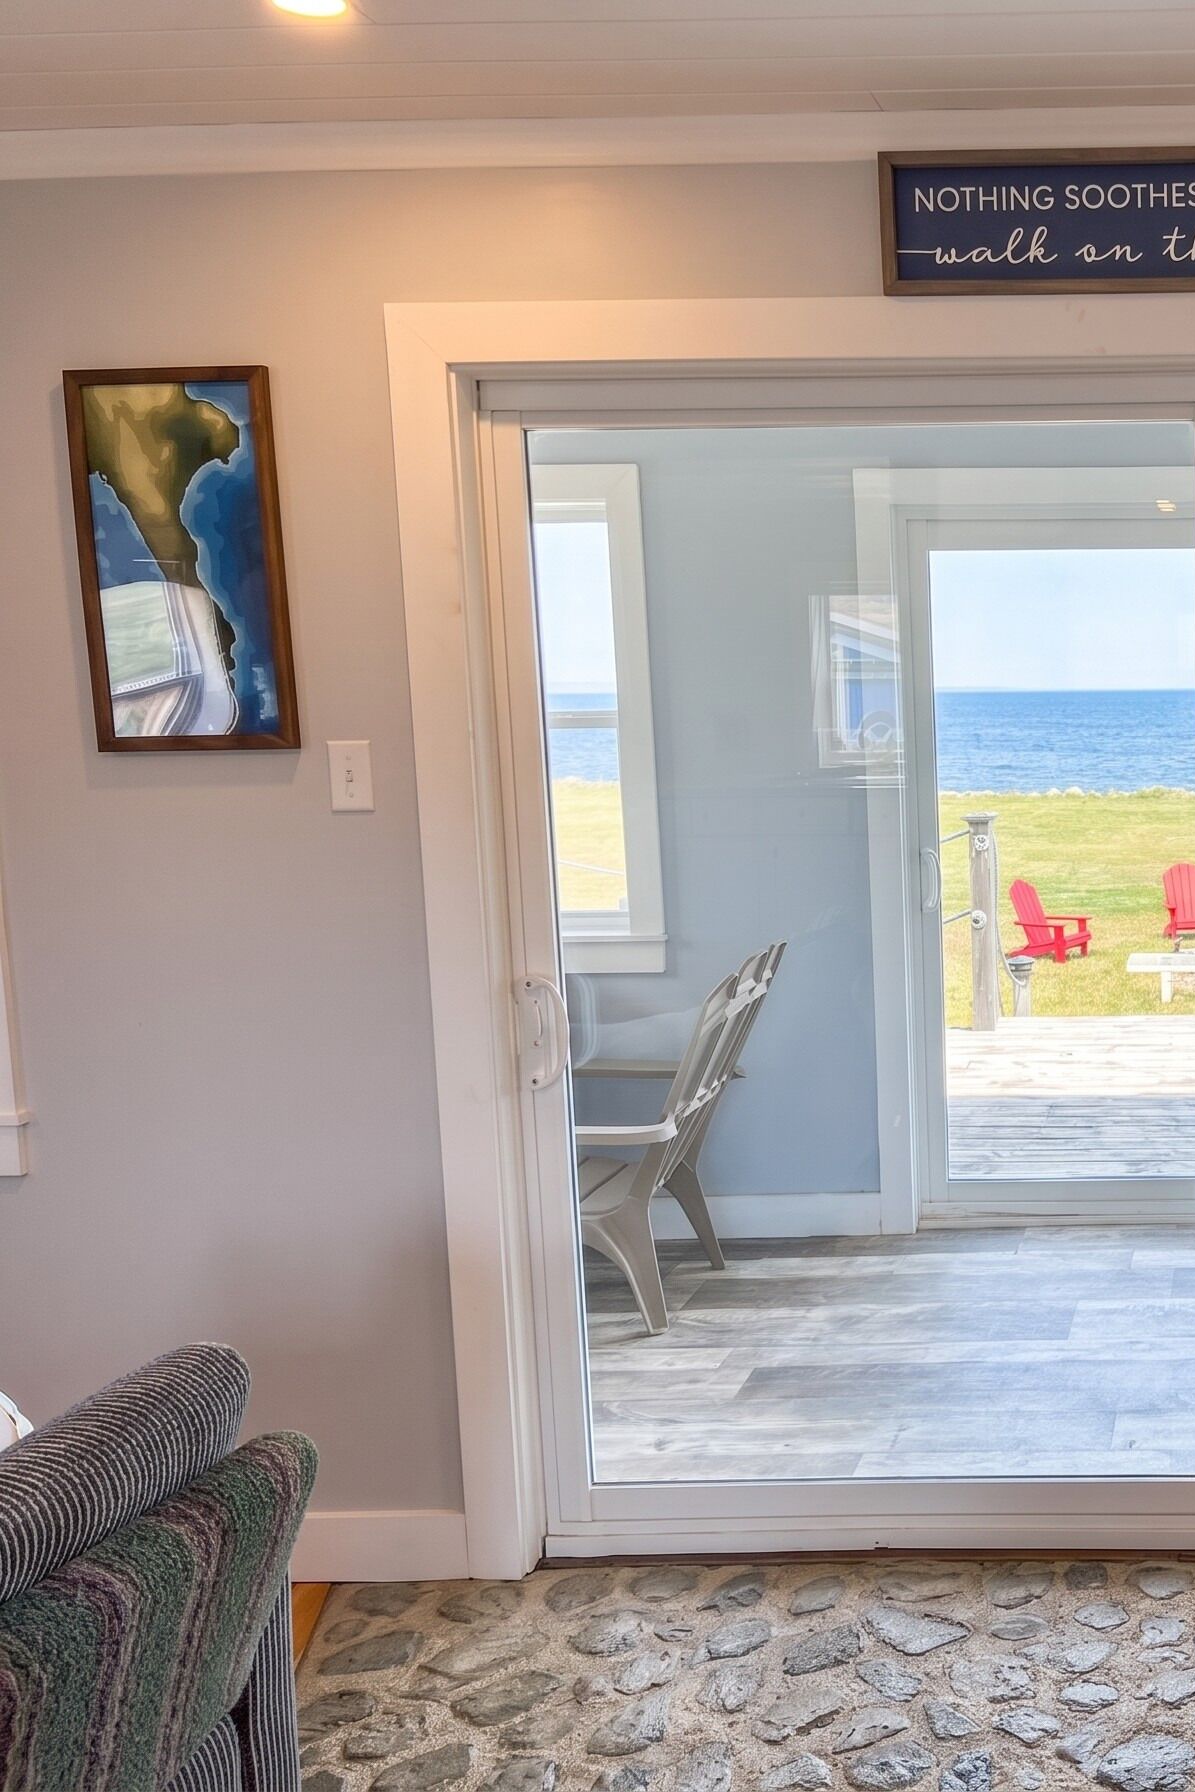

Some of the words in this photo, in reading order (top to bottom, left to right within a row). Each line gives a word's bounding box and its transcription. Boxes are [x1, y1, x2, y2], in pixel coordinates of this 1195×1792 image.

[914, 186, 1055, 213] NOTHING
[898, 225, 1058, 265] walk
[1074, 243, 1143, 263] on
